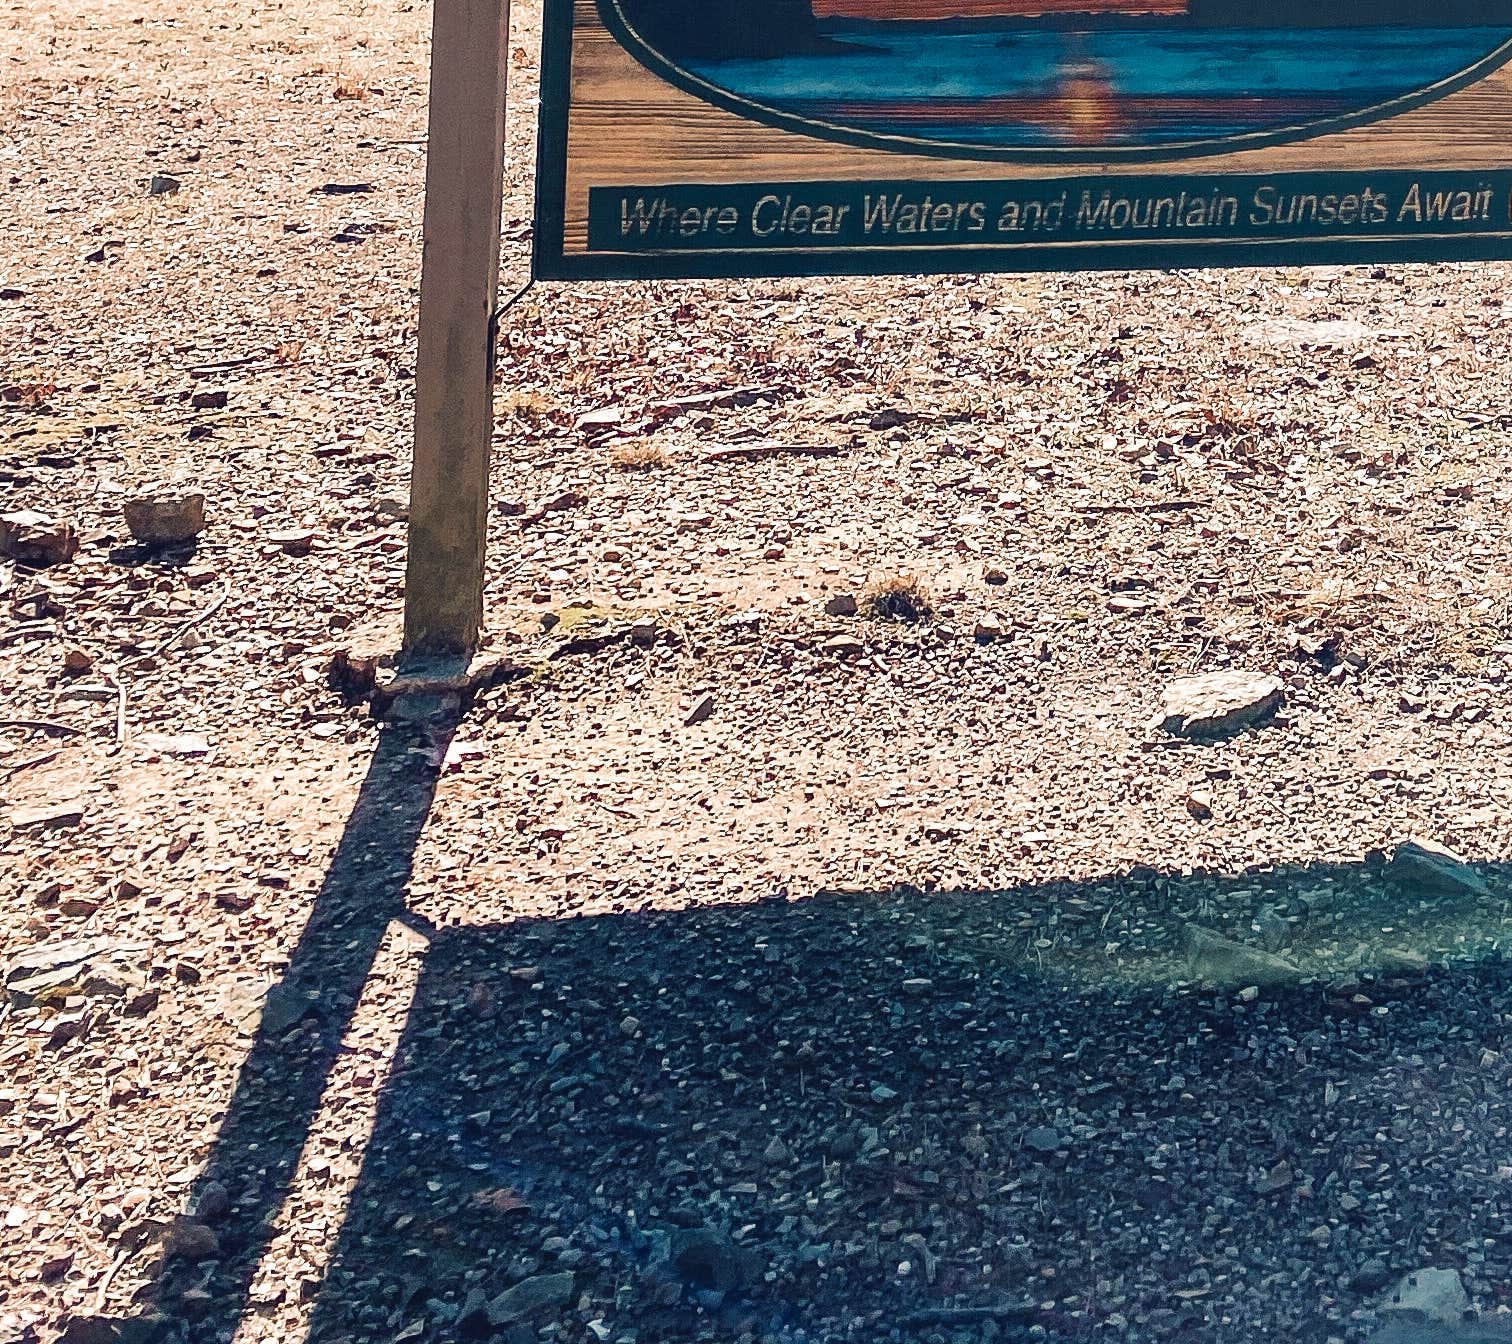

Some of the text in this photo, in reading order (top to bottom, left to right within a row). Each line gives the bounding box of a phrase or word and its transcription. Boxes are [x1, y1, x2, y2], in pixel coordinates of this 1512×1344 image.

[621, 182, 1494, 237] Where Clear Waters and Mountain Sunsets Await
